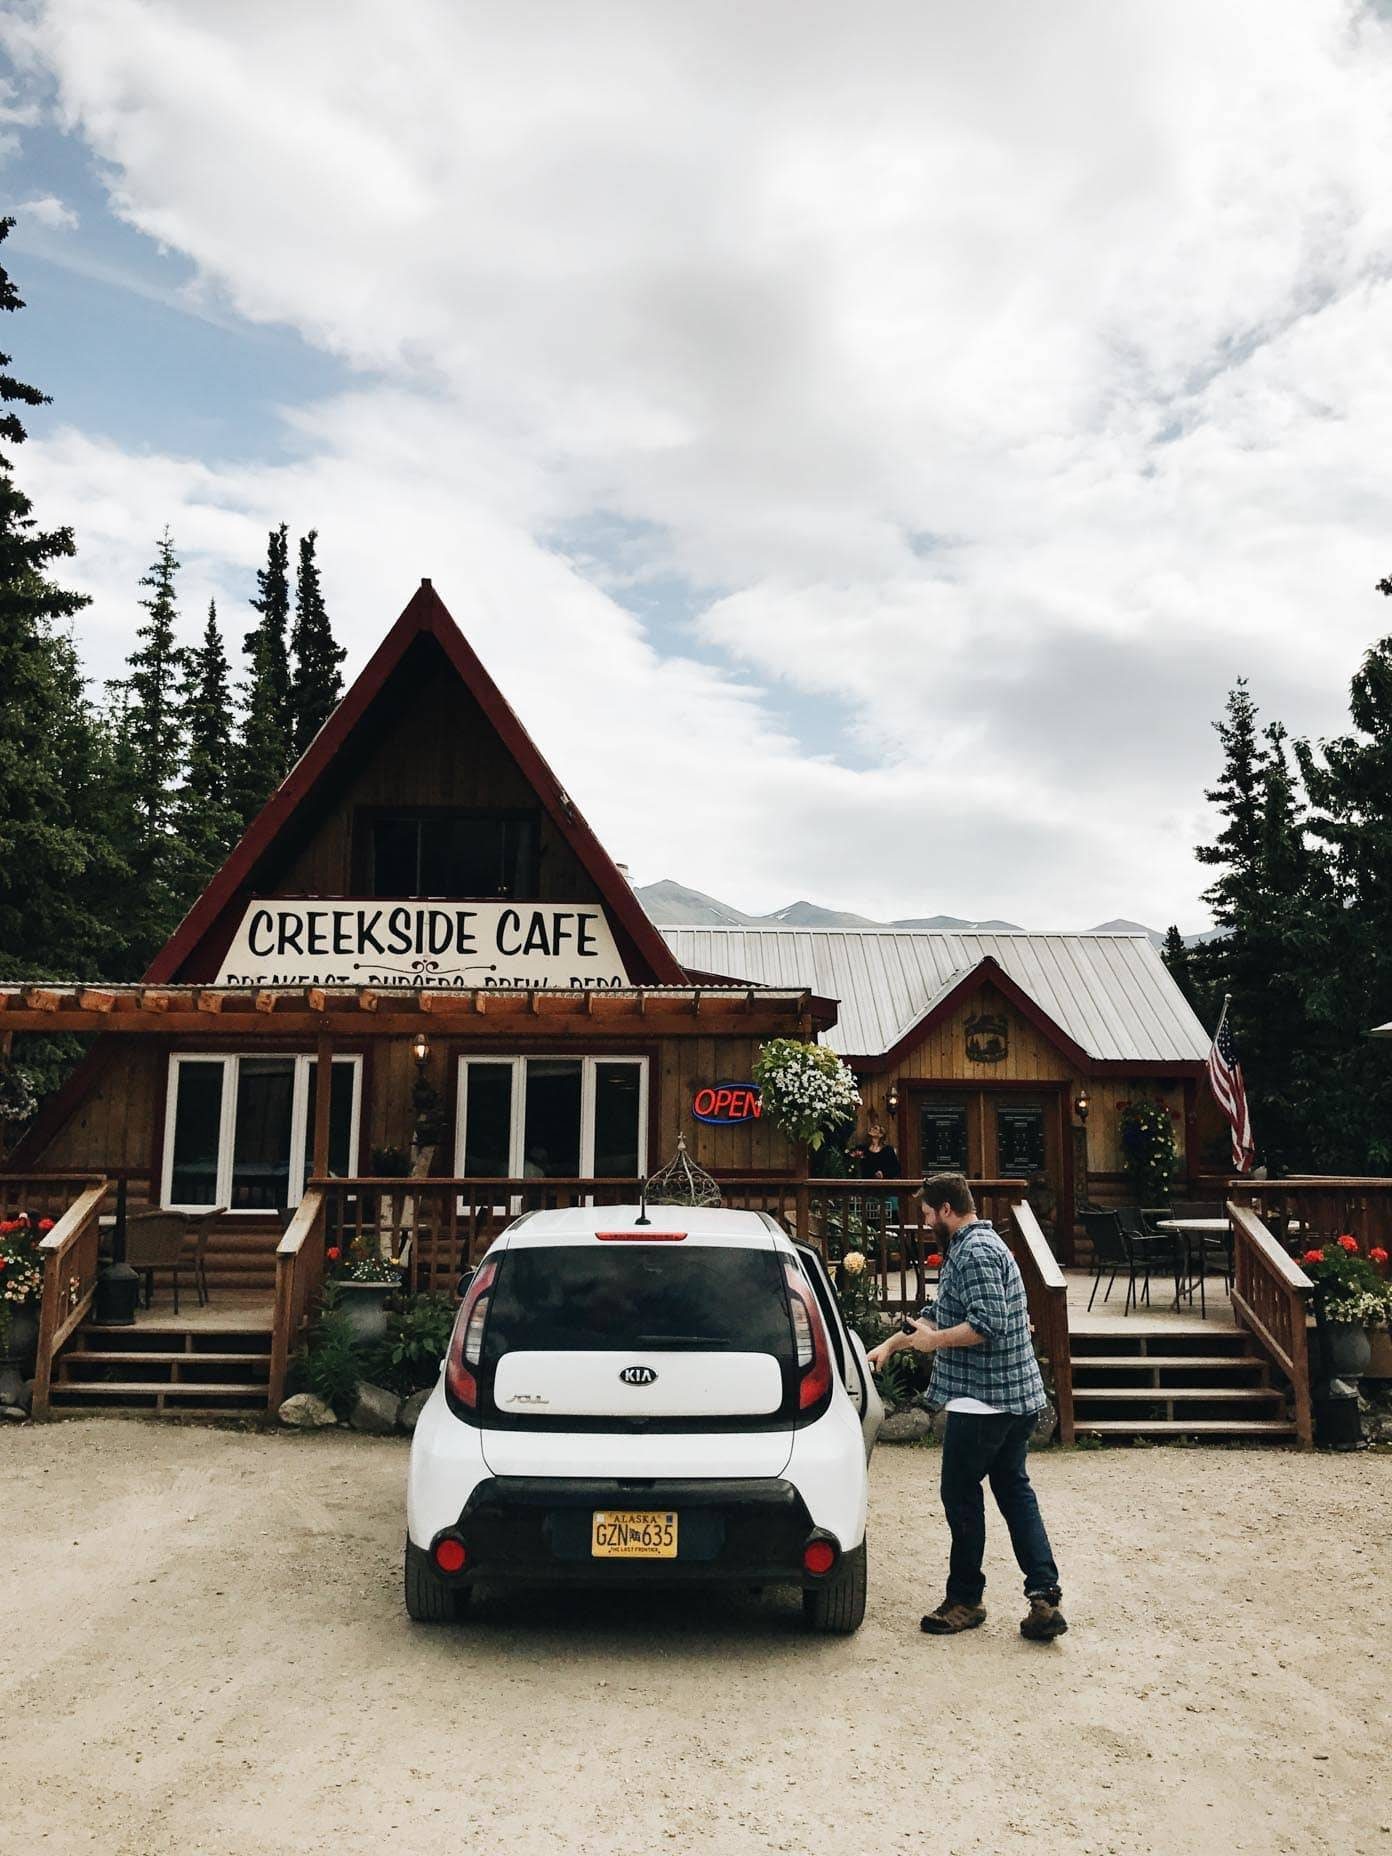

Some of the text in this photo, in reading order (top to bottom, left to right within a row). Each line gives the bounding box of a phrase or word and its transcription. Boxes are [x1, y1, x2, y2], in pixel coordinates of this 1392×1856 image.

[248, 907, 599, 957] CREEKSIDE CAFE
[695, 1089, 762, 1118] OPEN
[625, 1369, 652, 1382] KIA
[614, 1514, 657, 1524] ALASKA
[597, 1524, 673, 1546] GZN 635
